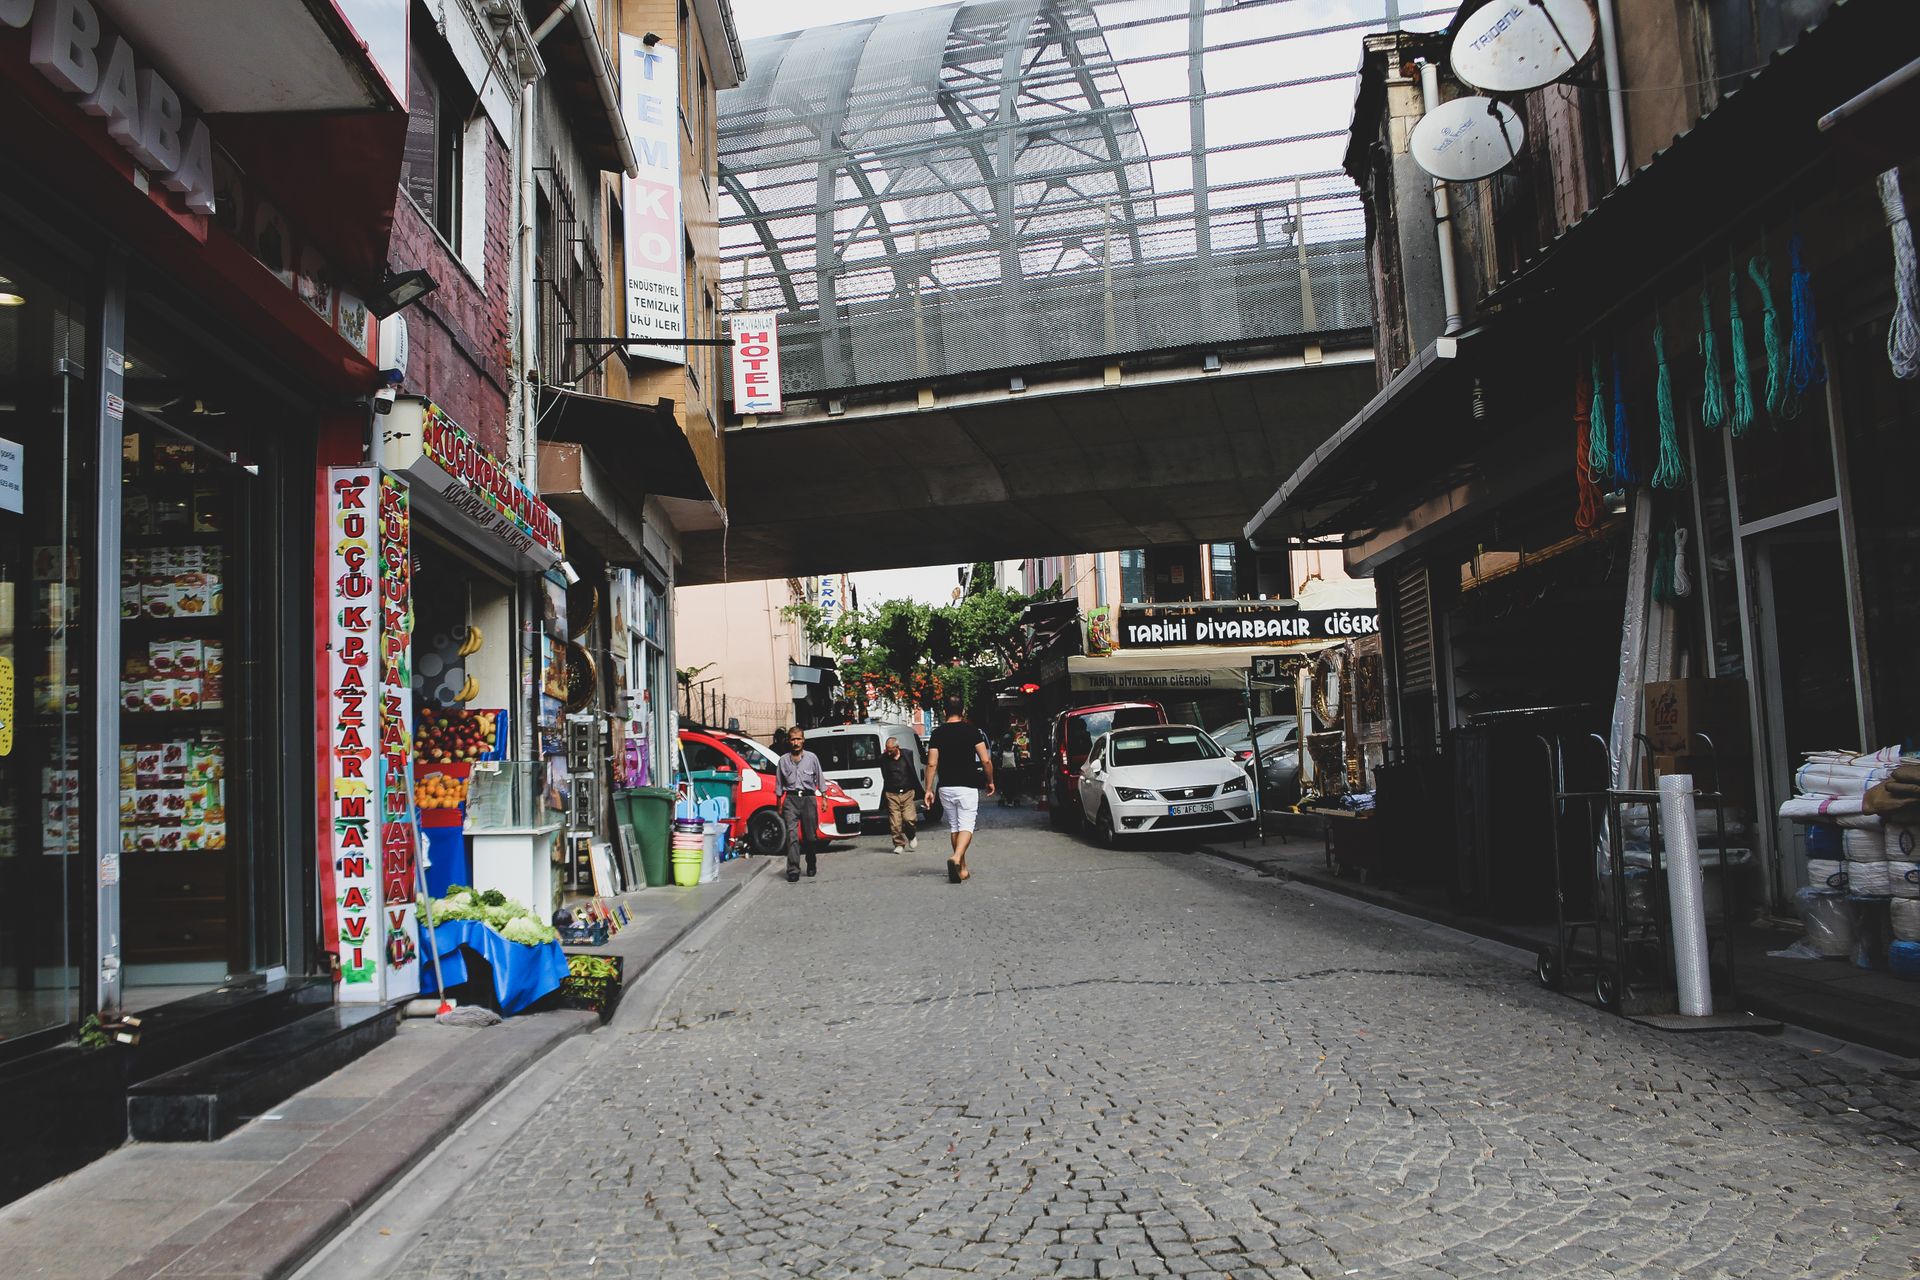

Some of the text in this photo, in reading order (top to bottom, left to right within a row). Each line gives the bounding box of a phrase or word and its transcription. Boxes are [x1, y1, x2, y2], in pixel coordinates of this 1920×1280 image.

[633, 50, 672, 263] TEMKO
[628, 279, 679, 297] ENDÜSTRİYEL
[634, 296, 680, 314] TEMİZLİK
[740, 331, 770, 398] HOTEL
[432, 414, 521, 517] KÜÇÜKPAZAR
[1128, 618, 1187, 643] TARİHİ
[1196, 617, 1311, 641] DİYARBAKIR
[1089, 674, 1211, 687] TARİHİ DİYARBAKIR CİĞERCİSİ
[341, 487, 367, 969] KÜÇÜKPAZAR MANAVI
[383, 486, 408, 962] KÜÇÜKPAZAR MANAVI
